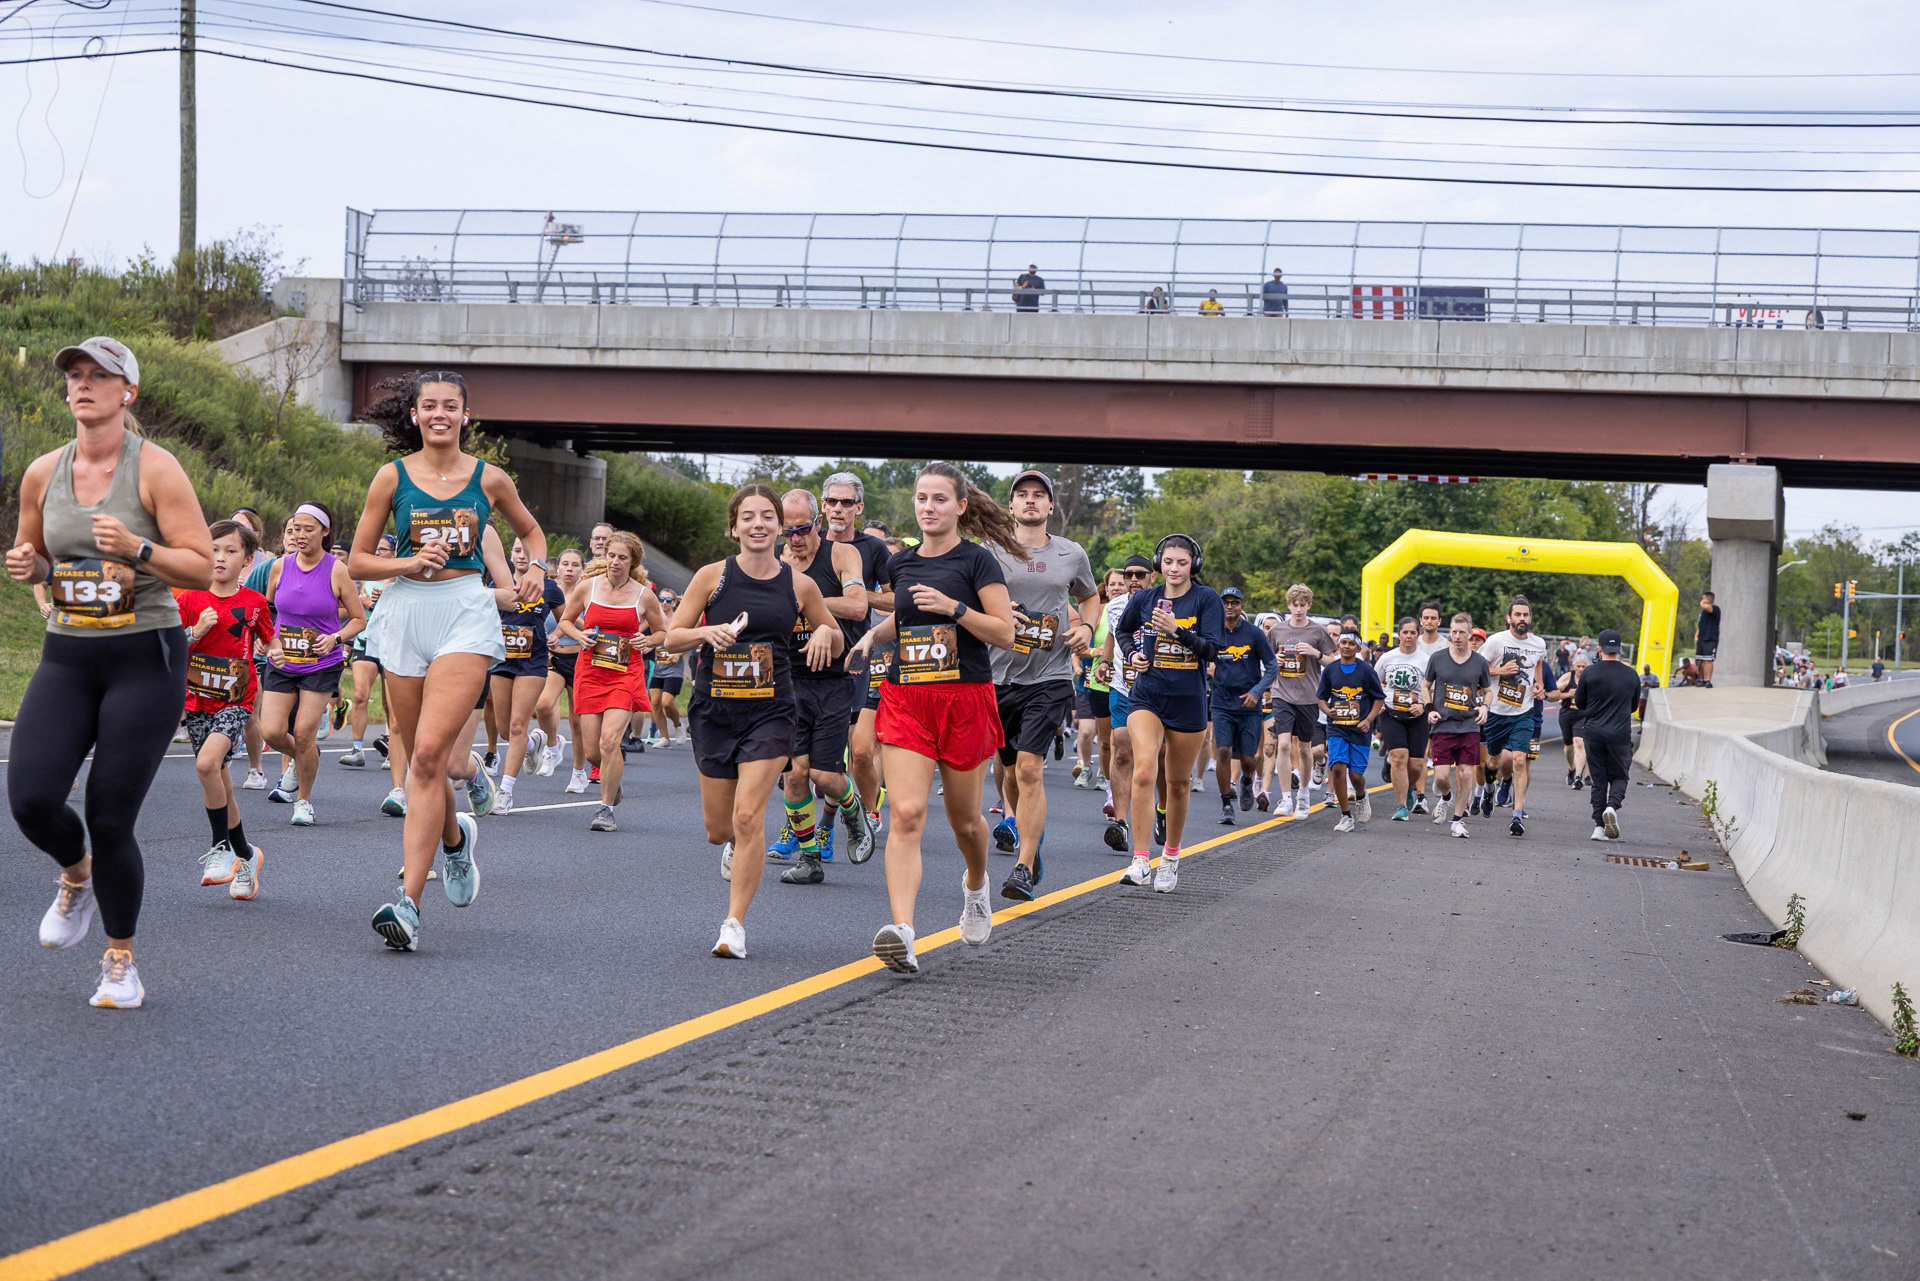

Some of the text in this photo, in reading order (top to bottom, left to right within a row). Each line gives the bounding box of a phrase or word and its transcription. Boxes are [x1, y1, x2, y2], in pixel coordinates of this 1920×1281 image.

[61, 580, 122, 602] 133
[505, 635, 527, 647] 30
[797, 633, 813, 641] CLU
[284, 637, 310, 650] 116
[605, 645, 618, 656] 4
[906, 643, 947, 661] 170
[191, 655, 206, 663] THE
[190, 662, 216, 671] CHASE
[723, 661, 760, 677] 171
[200, 671, 238, 692] 117
[1336, 708, 1358, 717] 274
